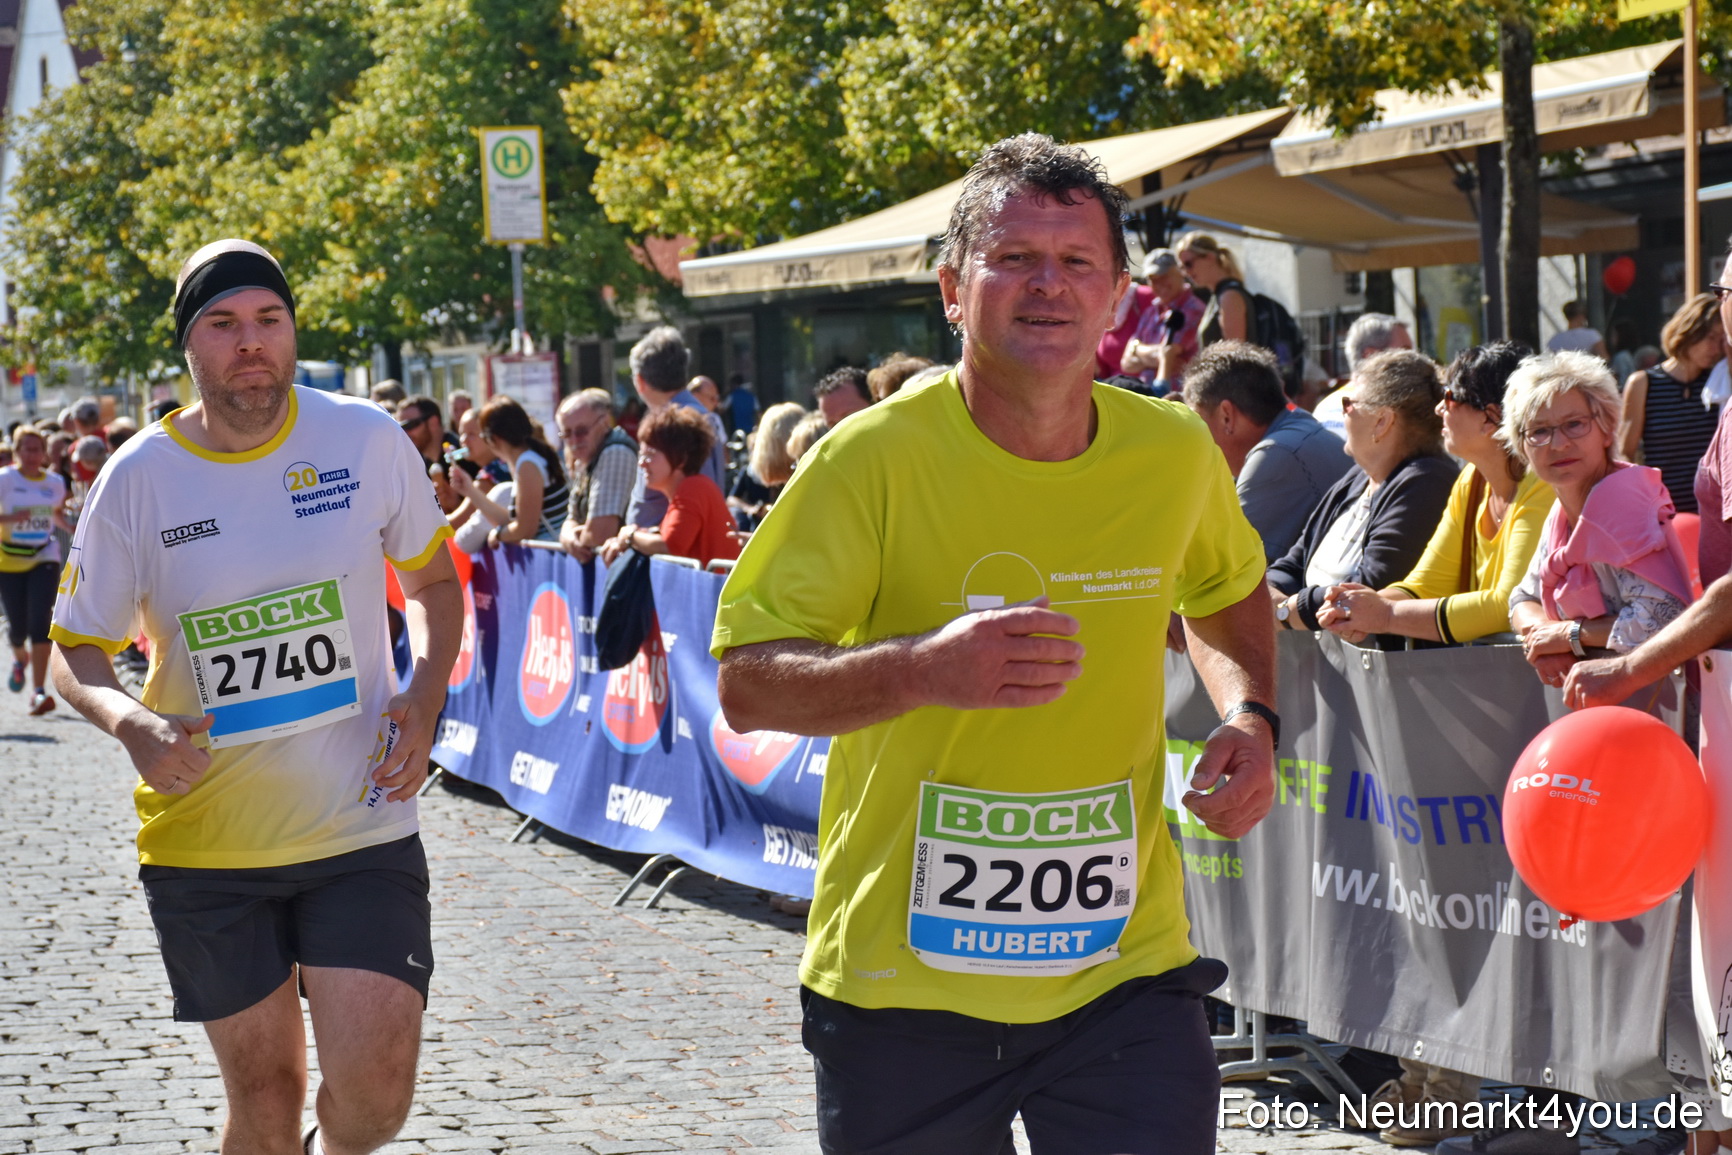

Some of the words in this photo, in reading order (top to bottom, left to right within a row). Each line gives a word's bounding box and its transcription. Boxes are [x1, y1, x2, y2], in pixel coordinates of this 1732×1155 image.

[287, 467, 317, 491] 20
[321, 470, 348, 483] JAHRE
[291, 481, 360, 504] Neumarkter
[295, 496, 350, 518] Stadtlauf
[161, 518, 219, 543] BOCK
[1051, 572, 1092, 582] Kliniken
[1096, 570, 1113, 579] des
[1115, 567, 1162, 577] Landkreises
[1083, 581, 1132, 593] Neumarkt
[192, 588, 331, 643] BOCK
[211, 634, 336, 697] 2740
[1549, 789, 1597, 806] energie
[936, 793, 1121, 841] BOCK
[763, 824, 790, 865] GET
[939, 854, 1113, 912] 2206
[1120, 857, 1128, 867] D
[952, 928, 1092, 955] HUBERT
